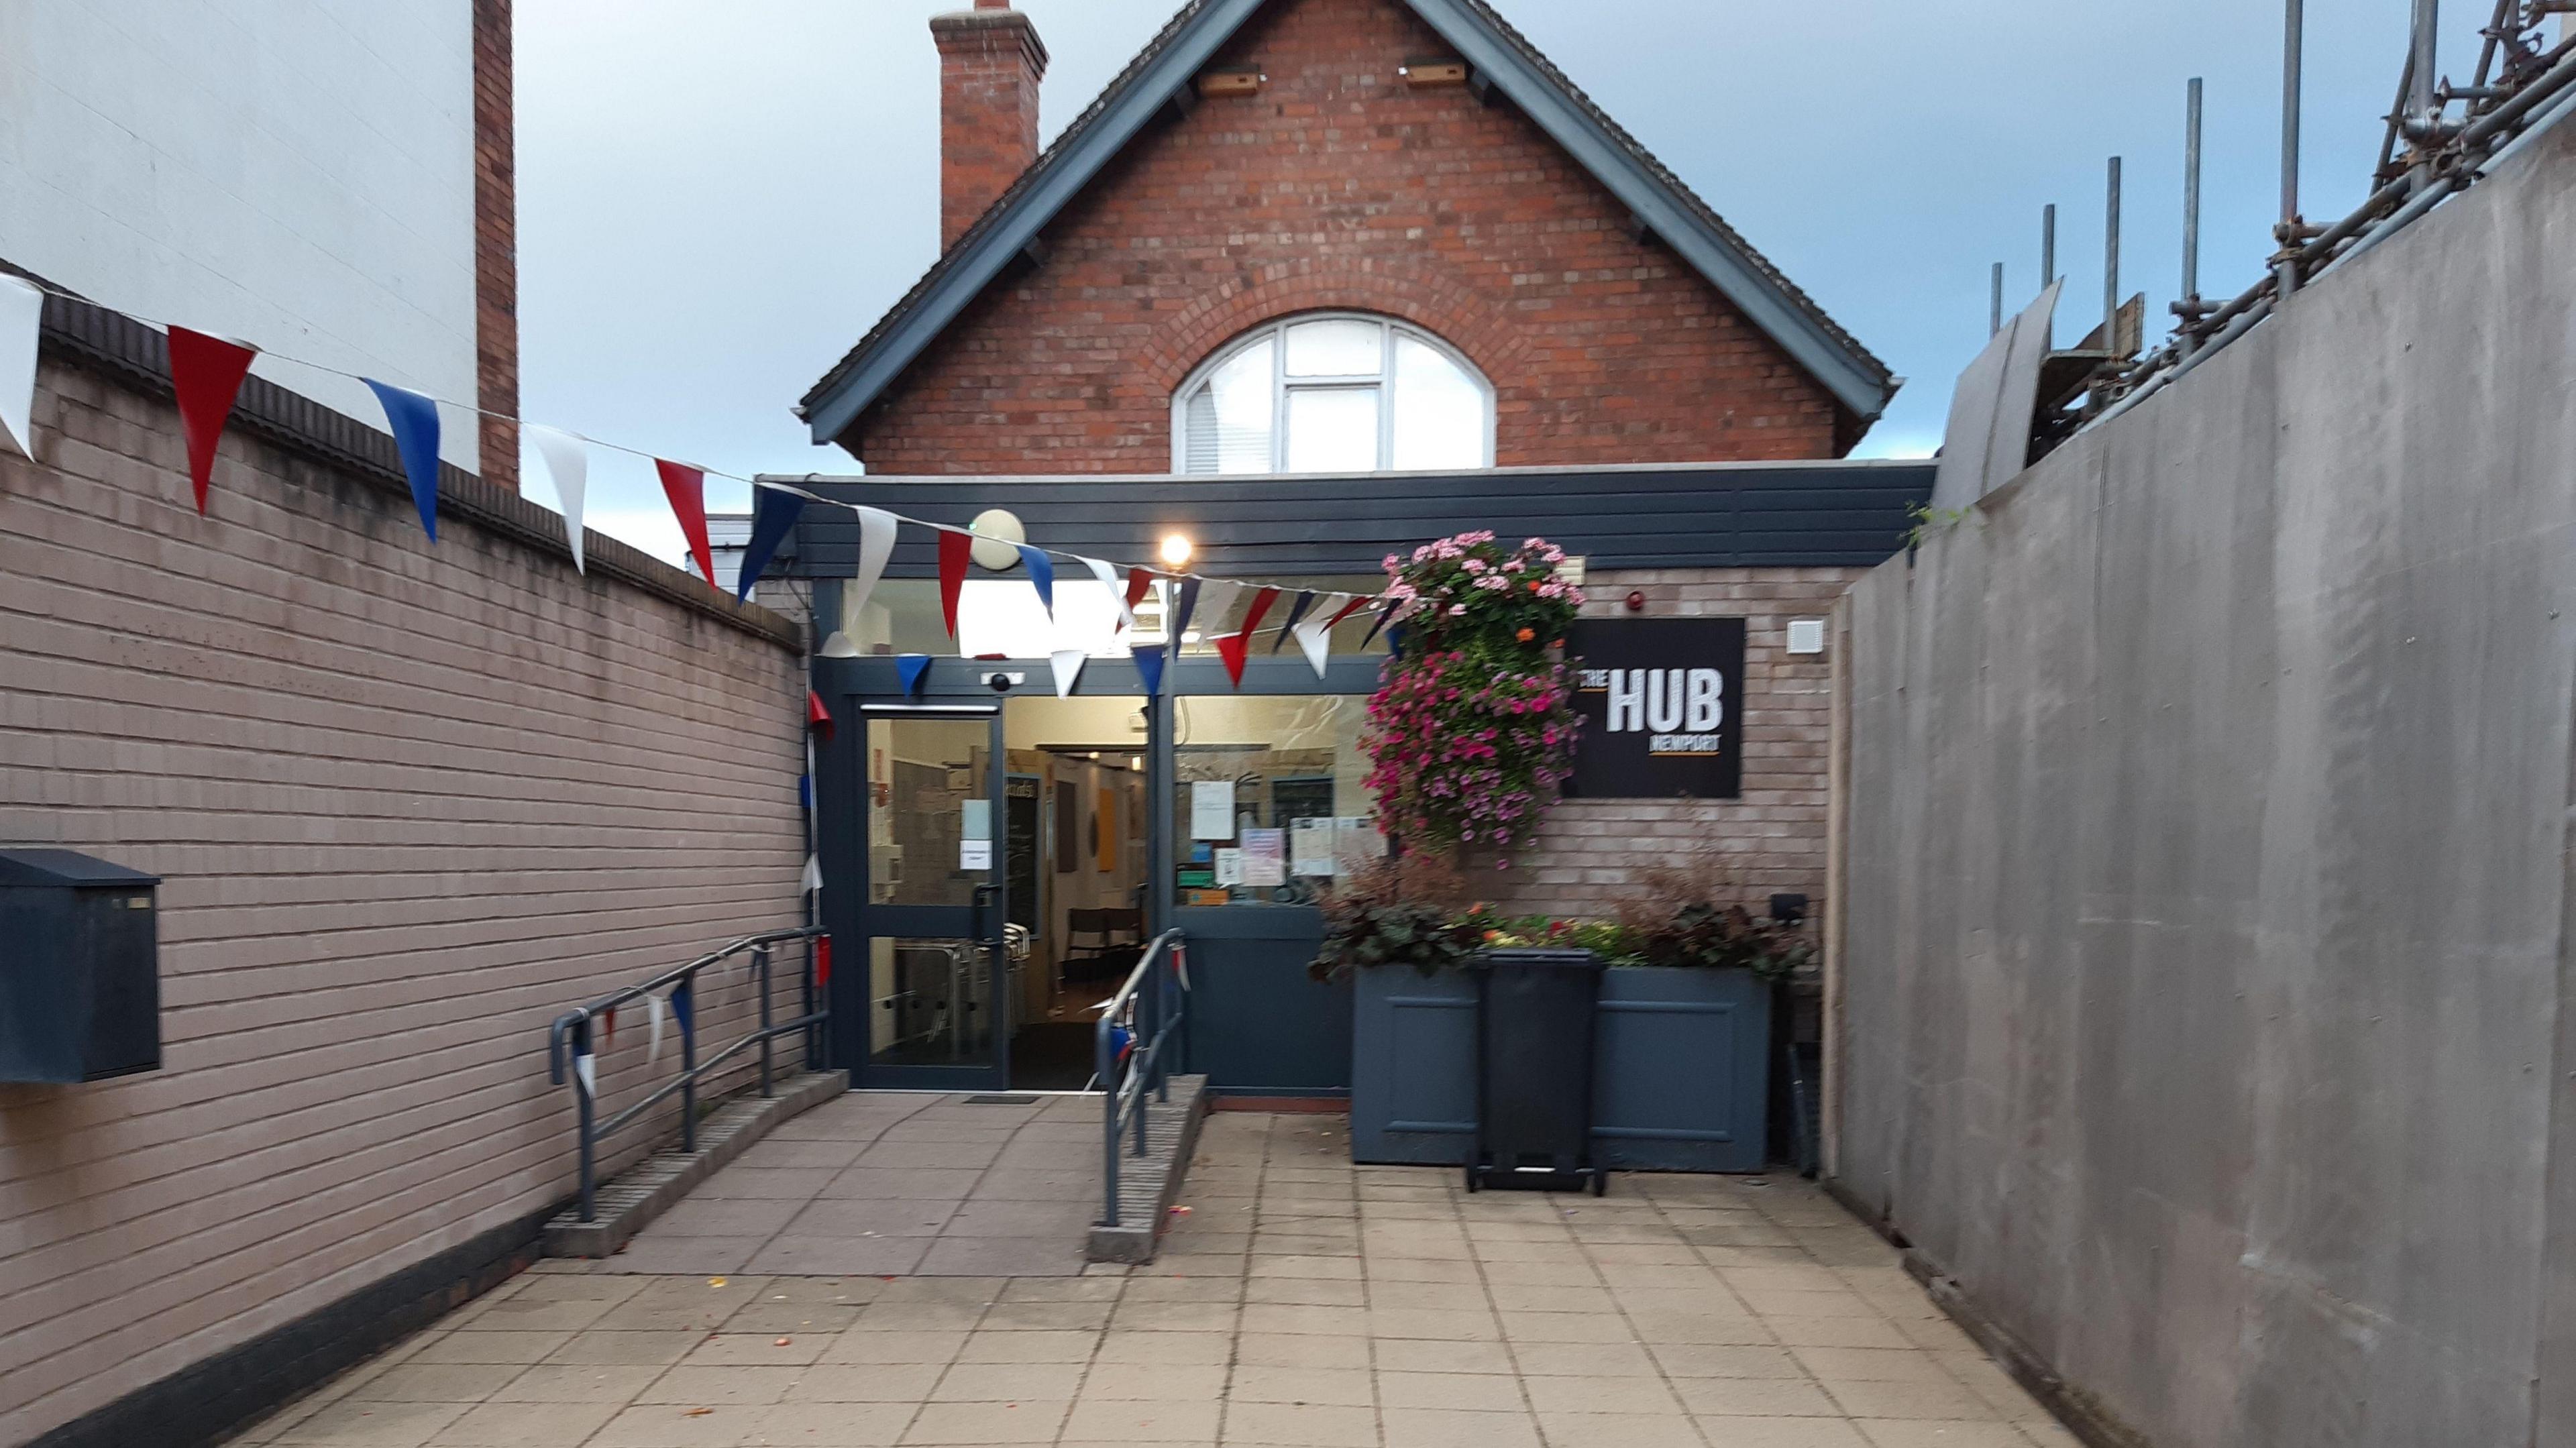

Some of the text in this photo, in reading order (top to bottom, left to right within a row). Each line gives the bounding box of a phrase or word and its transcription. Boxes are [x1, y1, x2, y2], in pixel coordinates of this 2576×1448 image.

[1578, 669, 1609, 687] THE
[1607, 669, 1723, 732] HUB
[1650, 734, 1721, 751] NEWPORT
